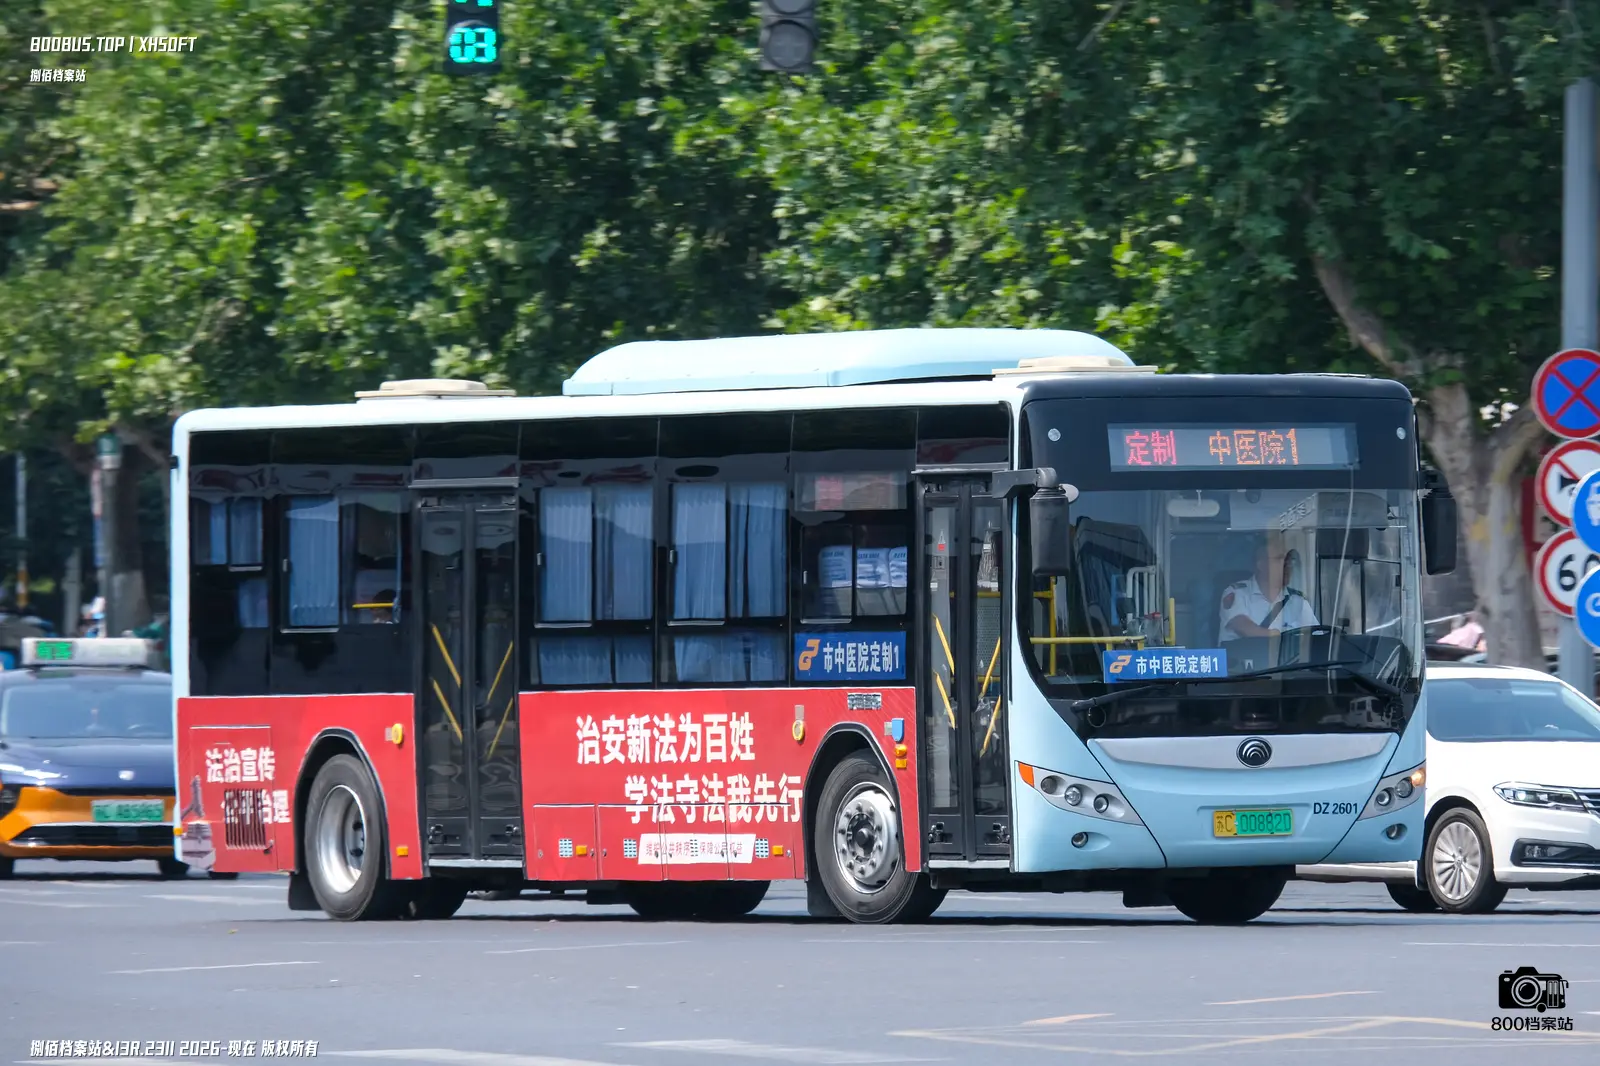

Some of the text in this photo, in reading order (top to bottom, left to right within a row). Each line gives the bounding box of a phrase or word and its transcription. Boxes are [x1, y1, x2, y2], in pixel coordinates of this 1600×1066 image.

[1125, 428, 1299, 465] 定制 中医院1
[823, 640, 899, 673] 市中医院定制1
[1135, 655, 1218, 675] 市中医院定制1
[576, 712, 756, 764] 治安新法为百姓
[205, 746, 276, 783] 法治宣传
[624, 773, 804, 824] 学法守法我先行
[1313, 802, 1359, 815] DZ 2601
